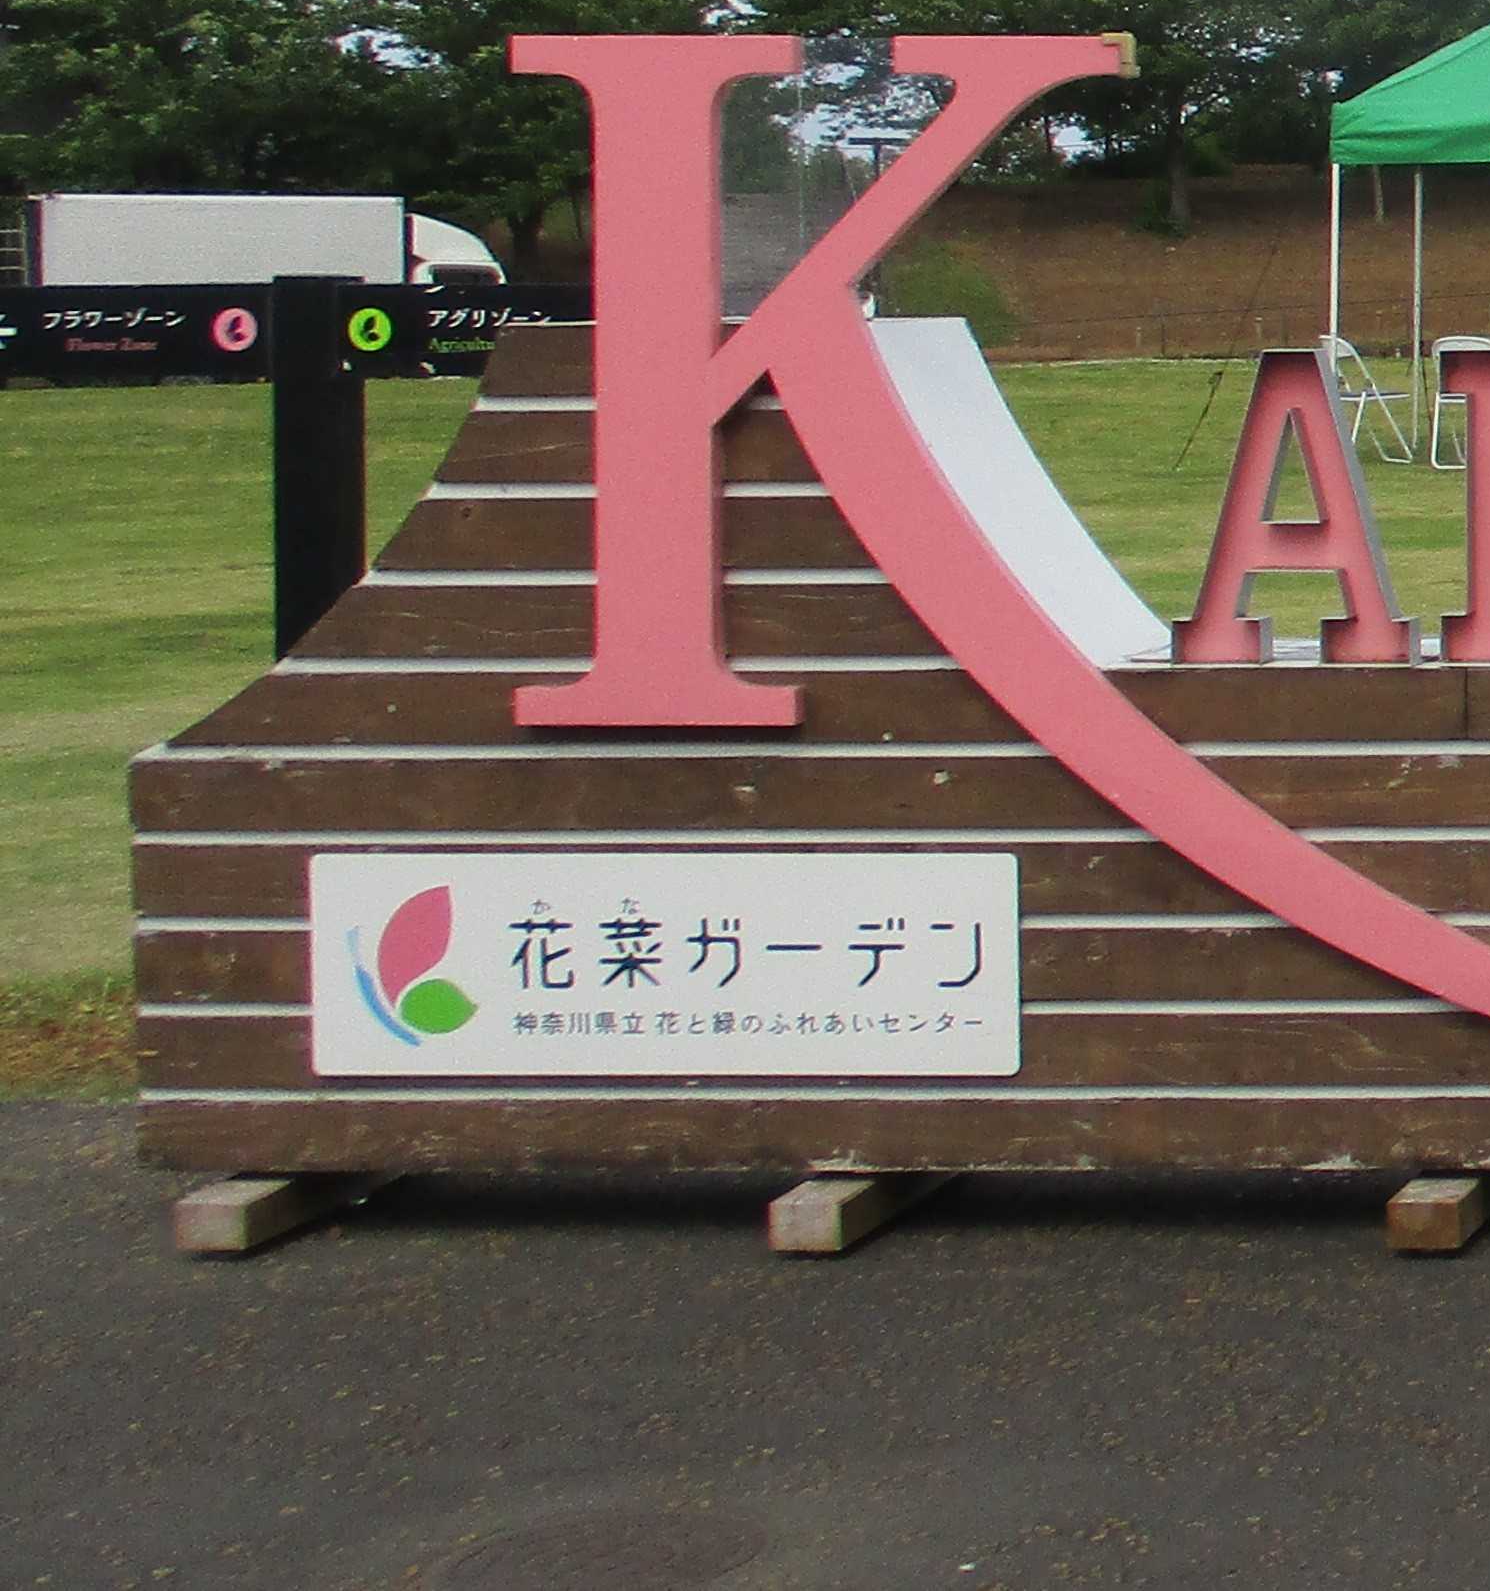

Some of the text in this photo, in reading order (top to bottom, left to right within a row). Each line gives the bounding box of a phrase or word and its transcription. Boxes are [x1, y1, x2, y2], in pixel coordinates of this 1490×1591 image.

[43, 307, 186, 330] フラワーゾーン
[428, 307, 551, 328] アグリゾーン
[508, 917, 983, 989] 花菜ガーデン
